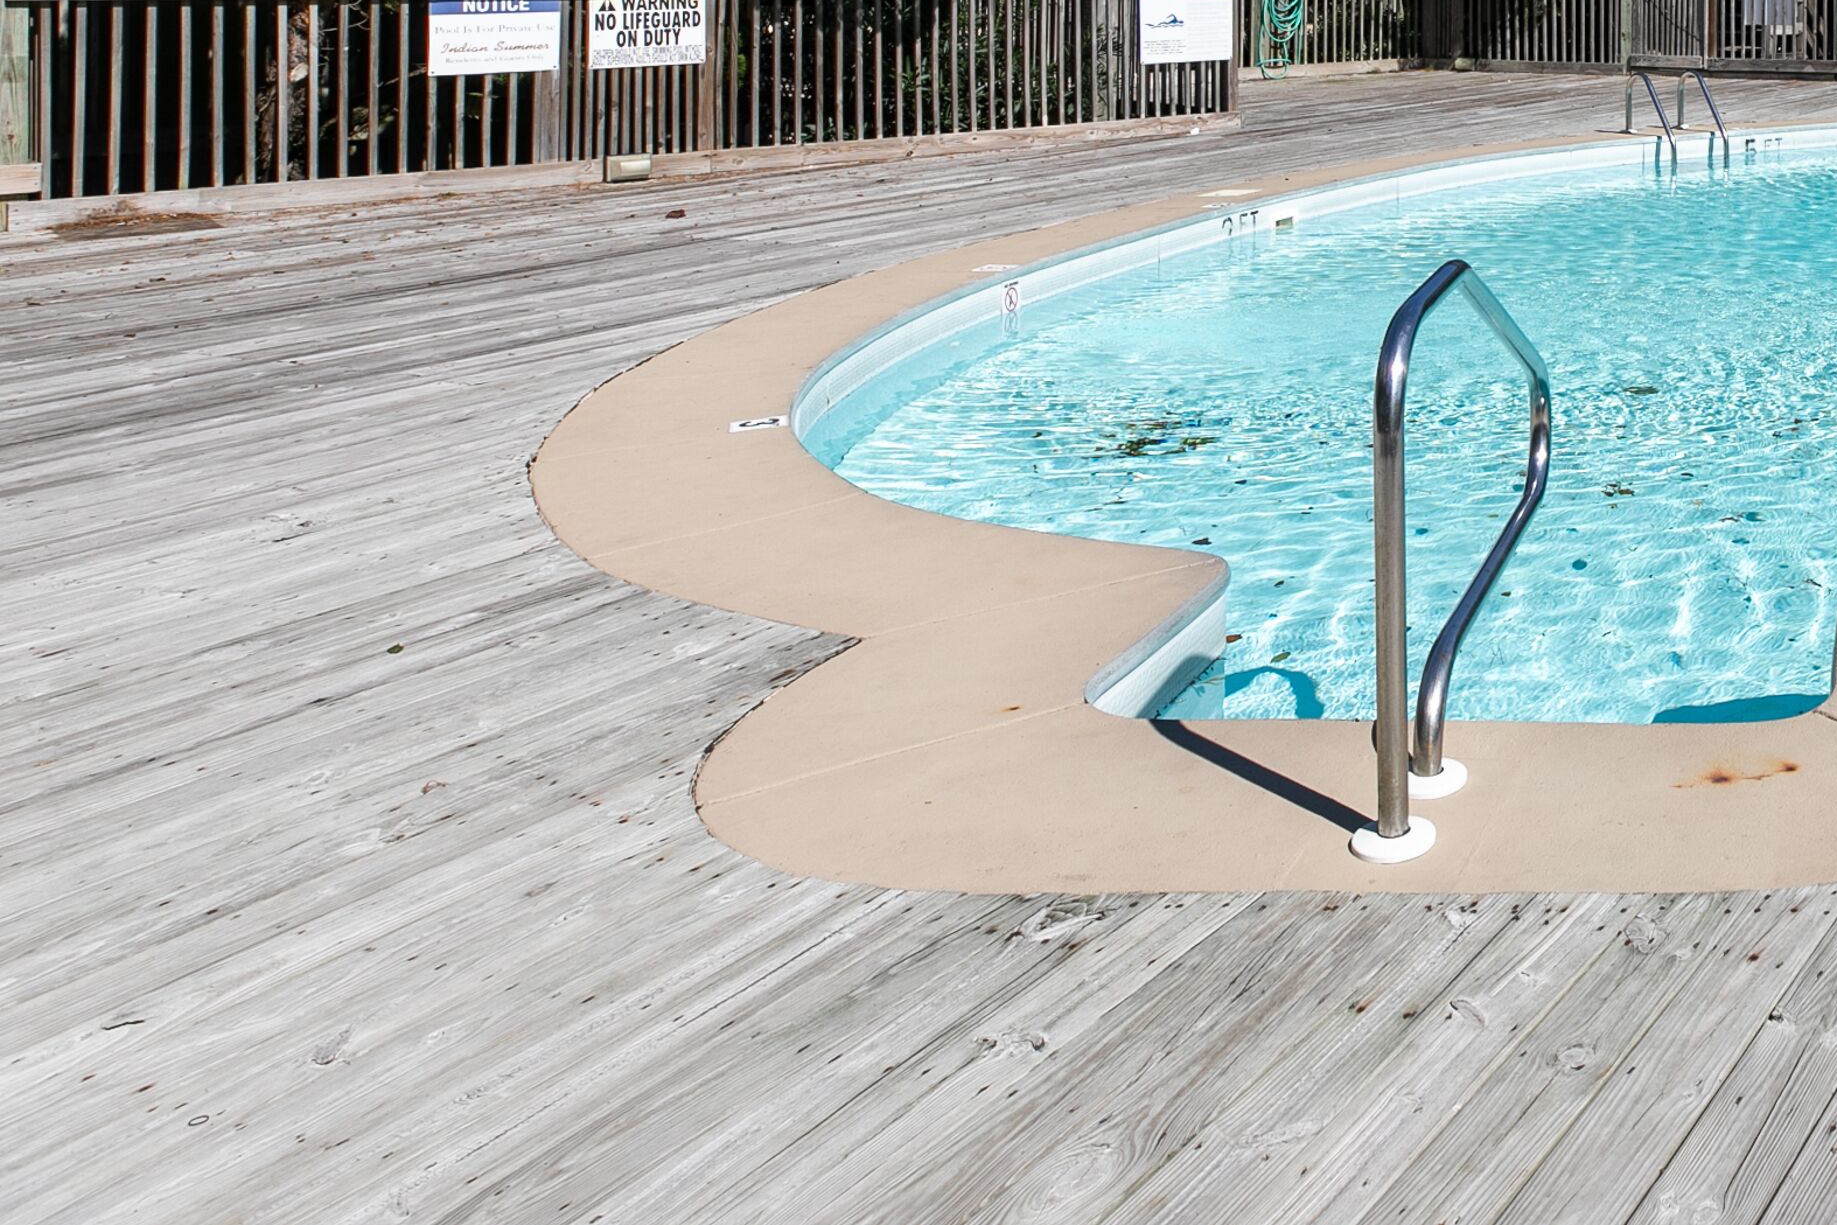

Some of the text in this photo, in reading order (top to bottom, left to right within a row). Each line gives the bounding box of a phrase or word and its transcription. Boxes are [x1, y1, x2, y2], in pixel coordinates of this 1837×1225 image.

[498, 24, 531, 32] Private
[595, 11, 701, 31] NO LIFEGUARD
[616, 28, 681, 48] ON DUTY
[441, 41, 550, 54] Indian Summer
